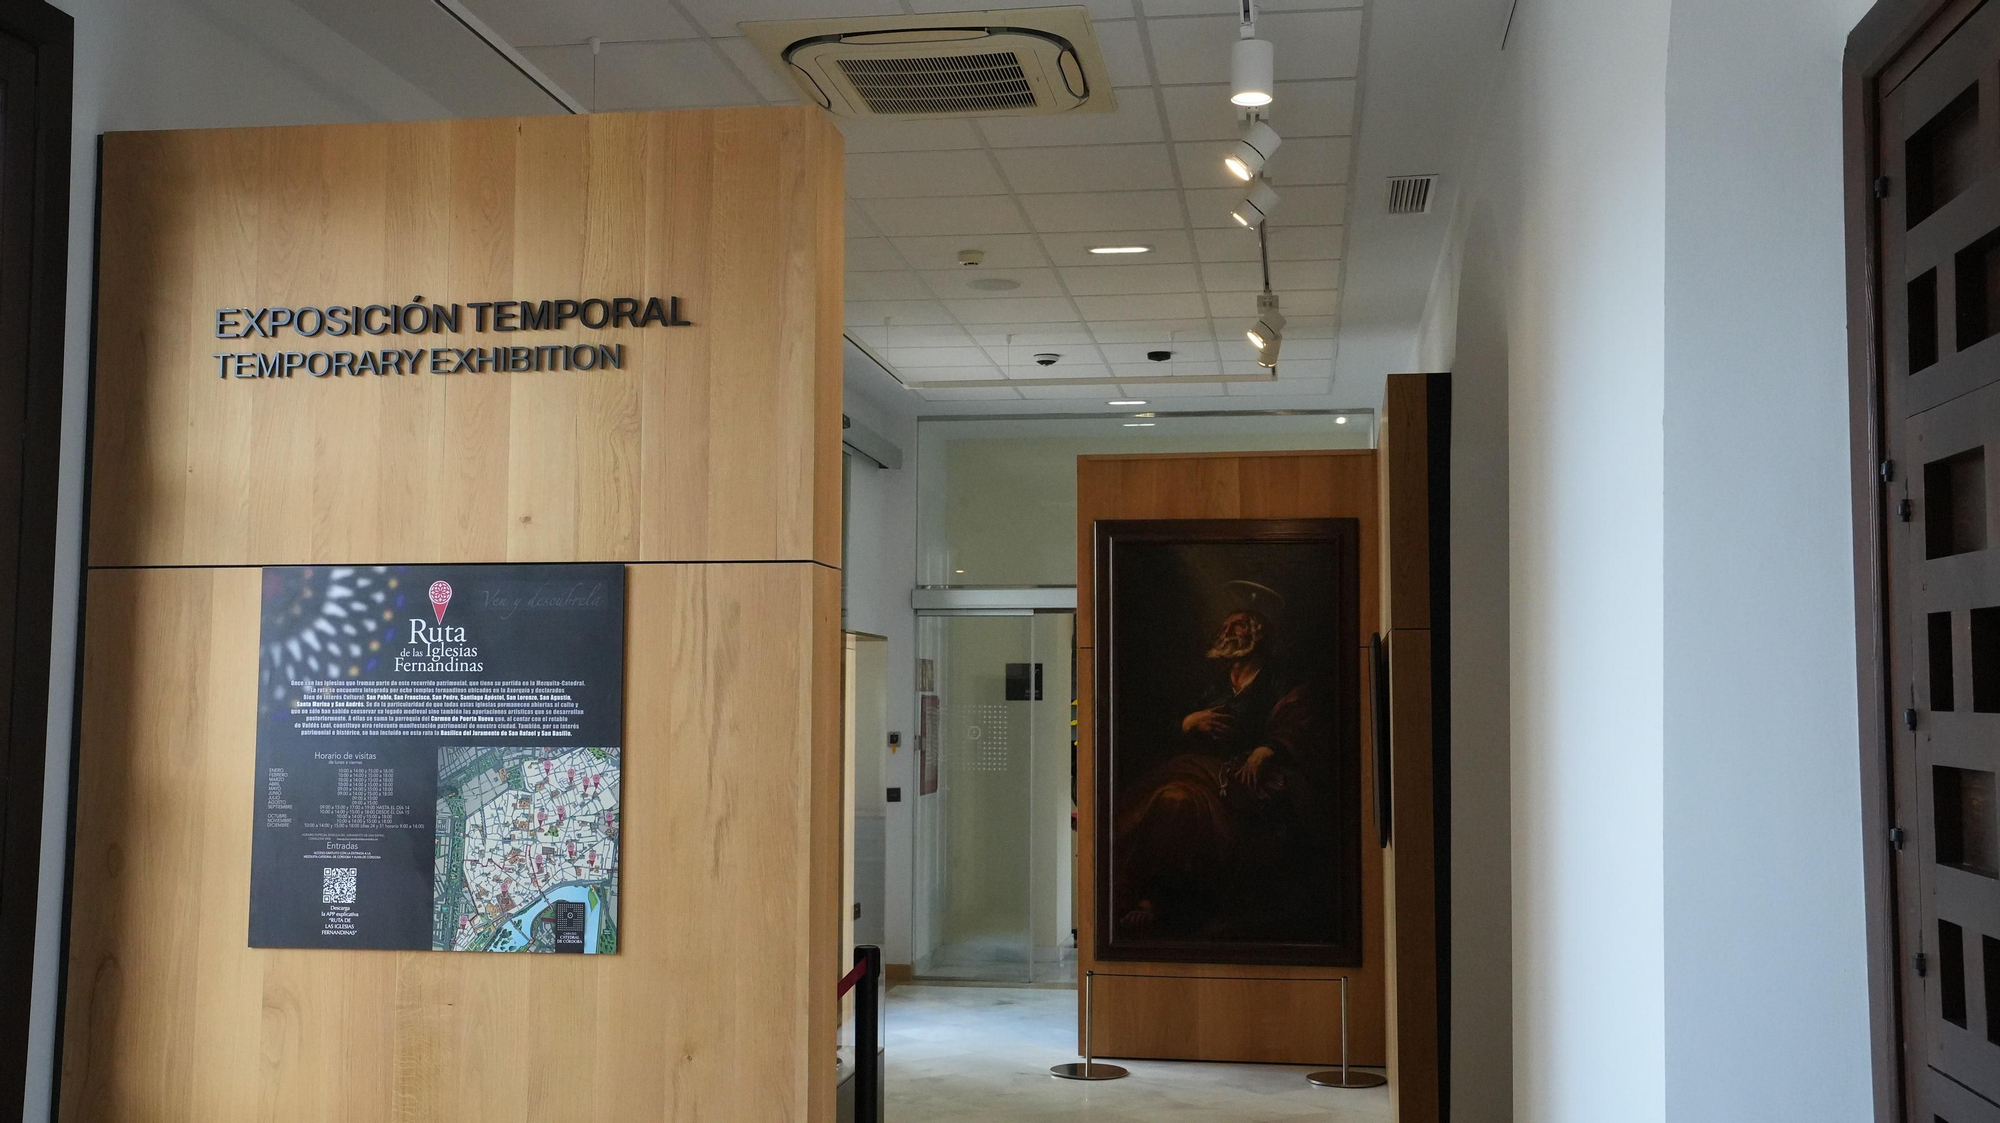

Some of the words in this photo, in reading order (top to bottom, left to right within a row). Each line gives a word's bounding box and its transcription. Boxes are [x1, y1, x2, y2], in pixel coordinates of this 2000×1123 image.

[214, 295, 458, 339] EXPOSICIÓN
[467, 296, 691, 332] TEMPORAL
[213, 347, 425, 379] TEMPORARY
[430, 343, 622, 375] EXHIBITION
[482, 590, 507, 607] Ven
[500, 598, 522, 619] y
[528, 582, 604, 608] descúbrela
[408, 618, 467, 644] Ruta
[394, 657, 484, 672] Fernandinas
[400, 648, 410, 657] de
[413, 648, 423, 657] las
[426, 642, 478, 662] Iglesias
[327, 842, 358, 850] Entradas
